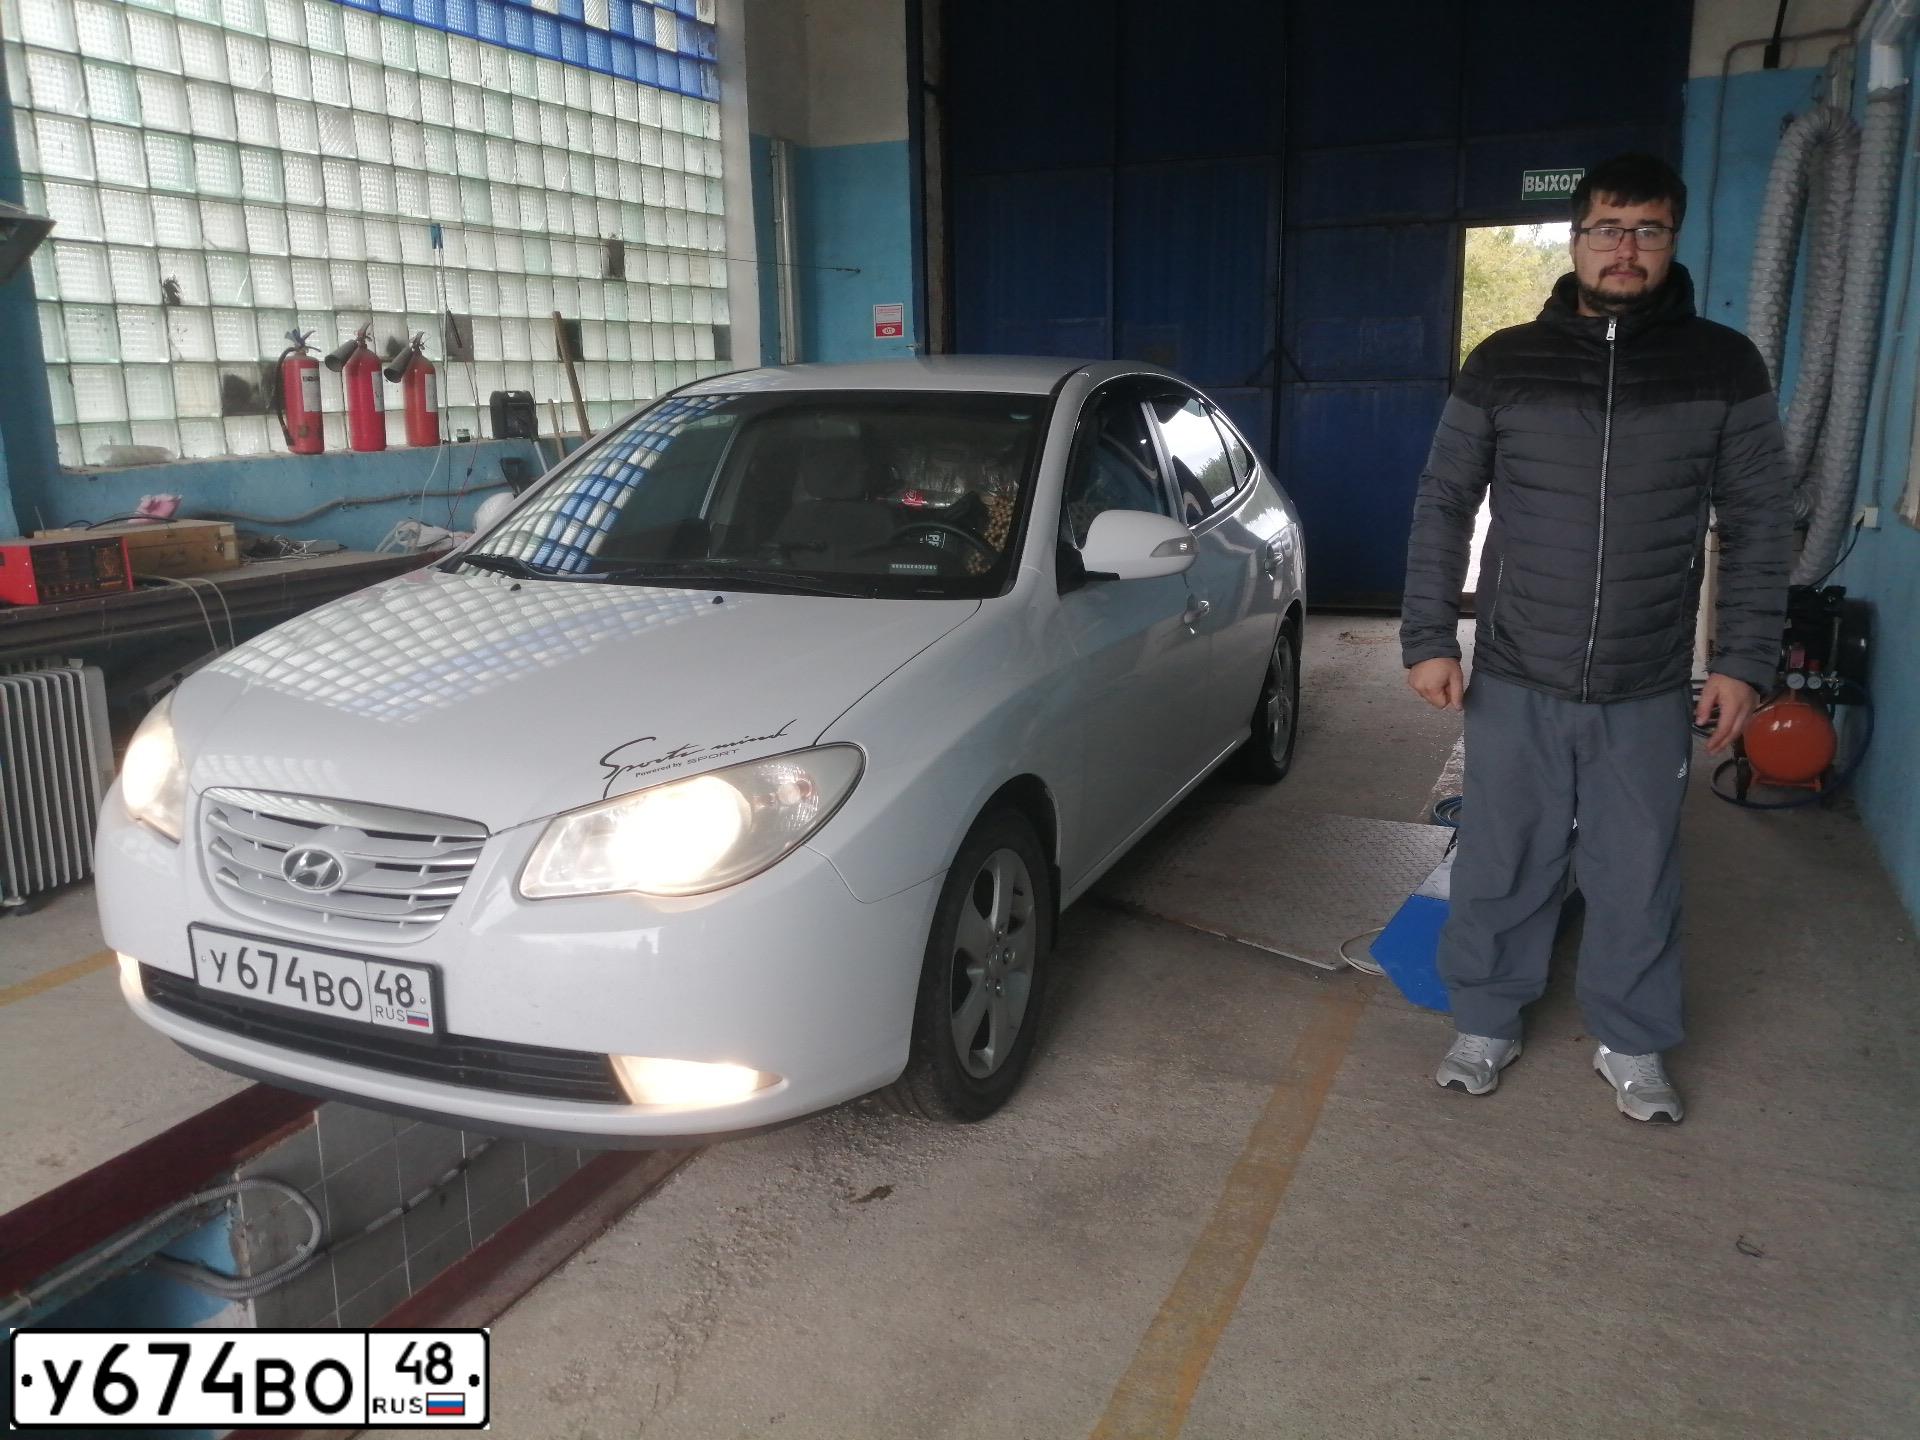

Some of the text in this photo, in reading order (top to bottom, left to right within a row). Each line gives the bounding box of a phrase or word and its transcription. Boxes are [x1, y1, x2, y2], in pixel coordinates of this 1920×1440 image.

[1524, 173, 1582, 194] ВЫХОД
[635, 764, 671, 778] Powered
[688, 748, 740, 765] SPORT
[209, 946, 415, 1012] У674ВО 48
[375, 1005, 405, 1022] RUS
